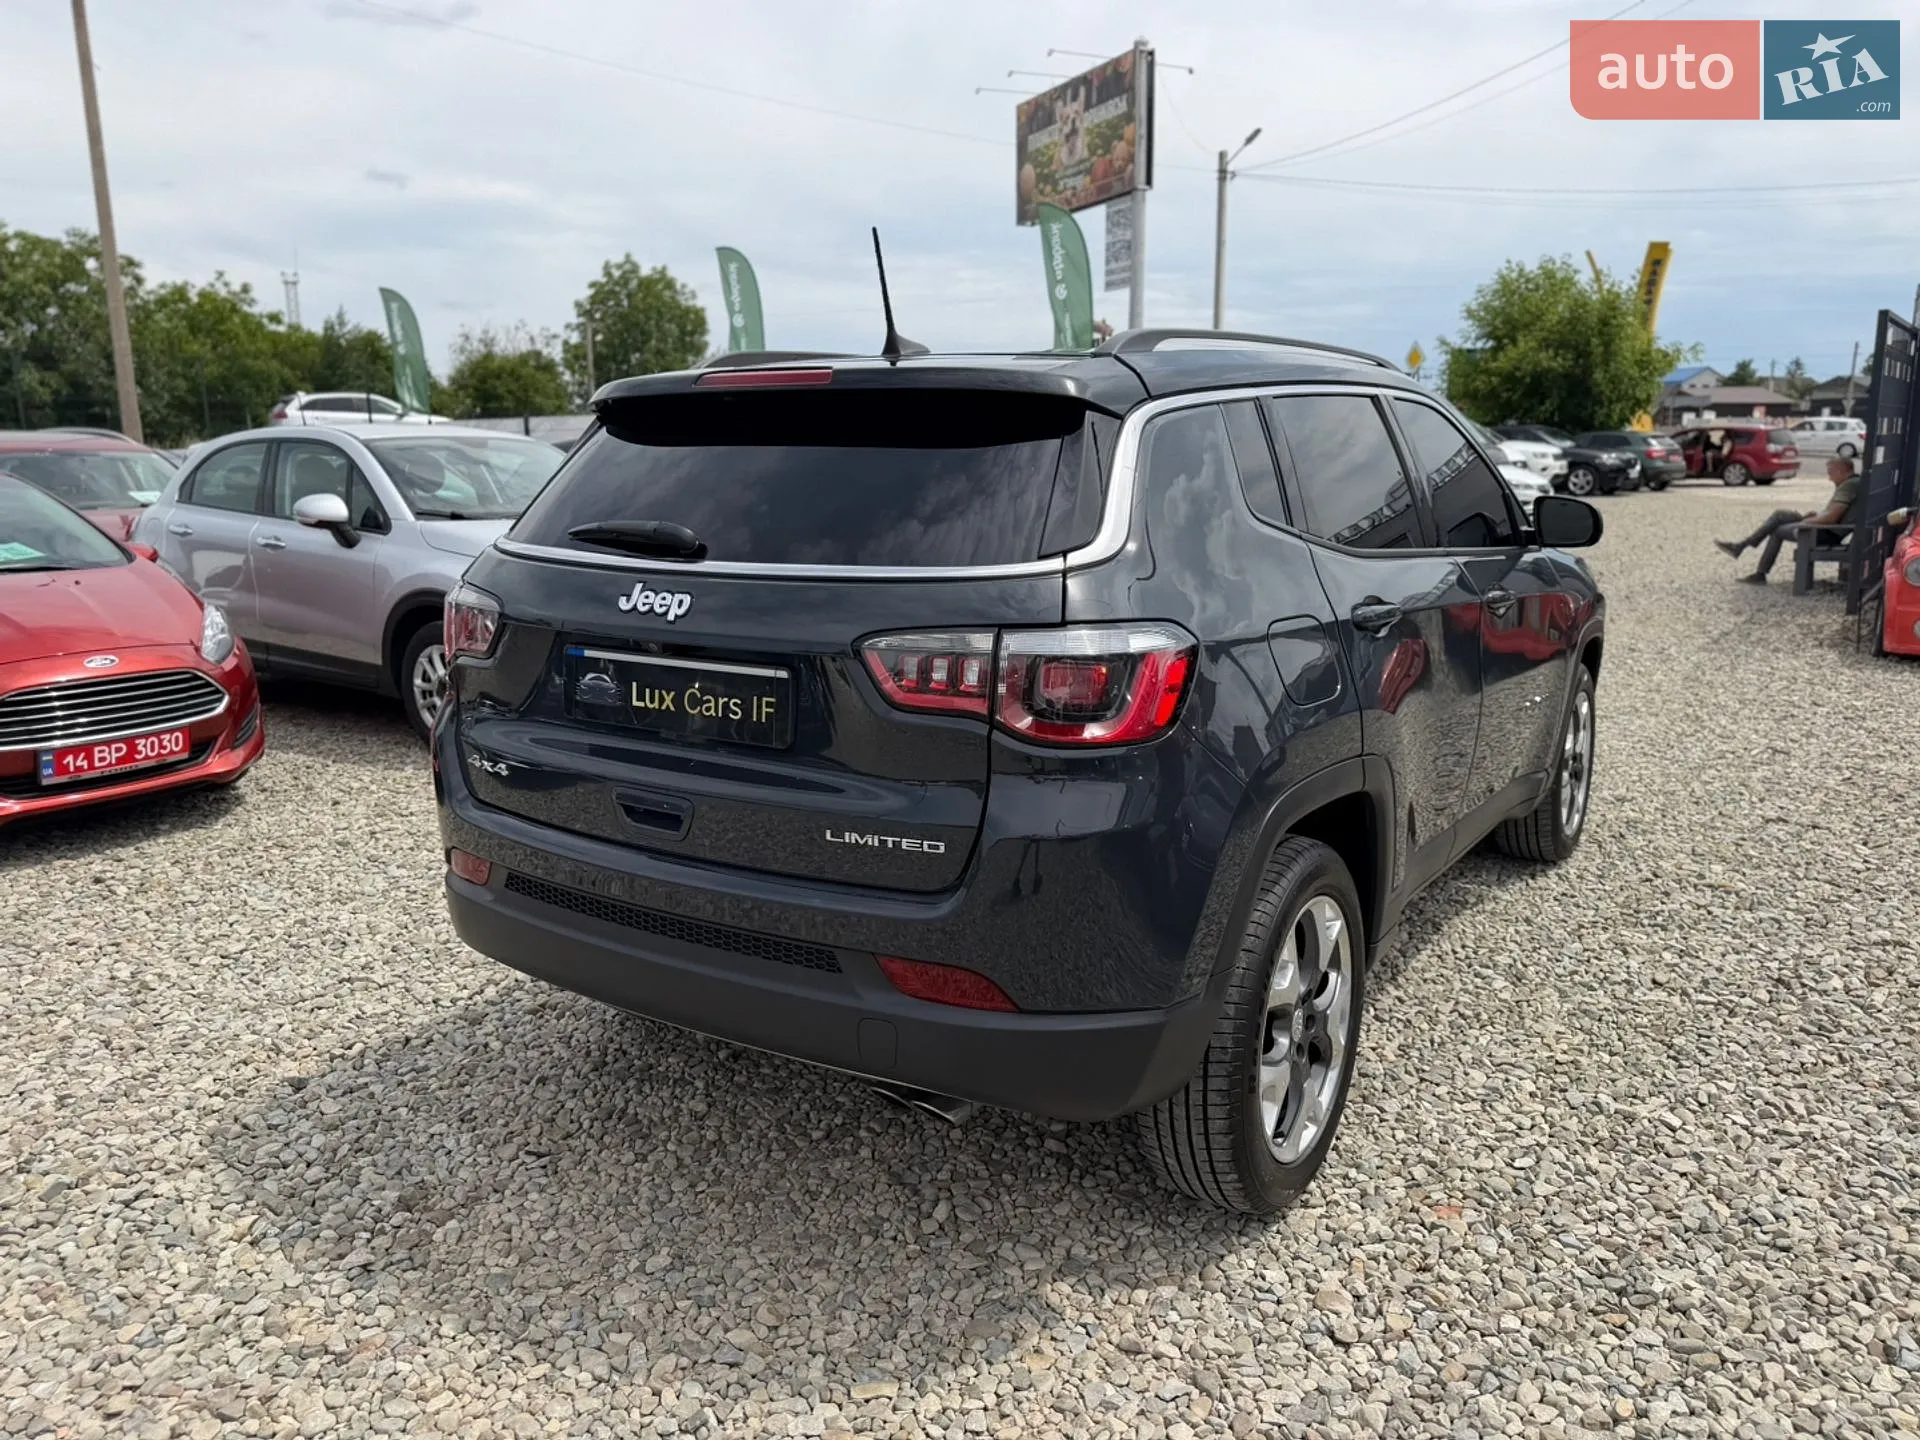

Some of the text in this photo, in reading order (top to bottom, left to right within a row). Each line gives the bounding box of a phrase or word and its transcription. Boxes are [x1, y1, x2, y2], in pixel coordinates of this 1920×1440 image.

[618, 582, 692, 622] Jeep
[631, 681, 777, 723] Lux Cars IF
[42, 767, 54, 776] UA
[62, 752, 88, 772] 14
[93, 743, 127, 767] BP
[134, 731, 184, 759] 3030
[825, 829, 946, 854] LIMITED
